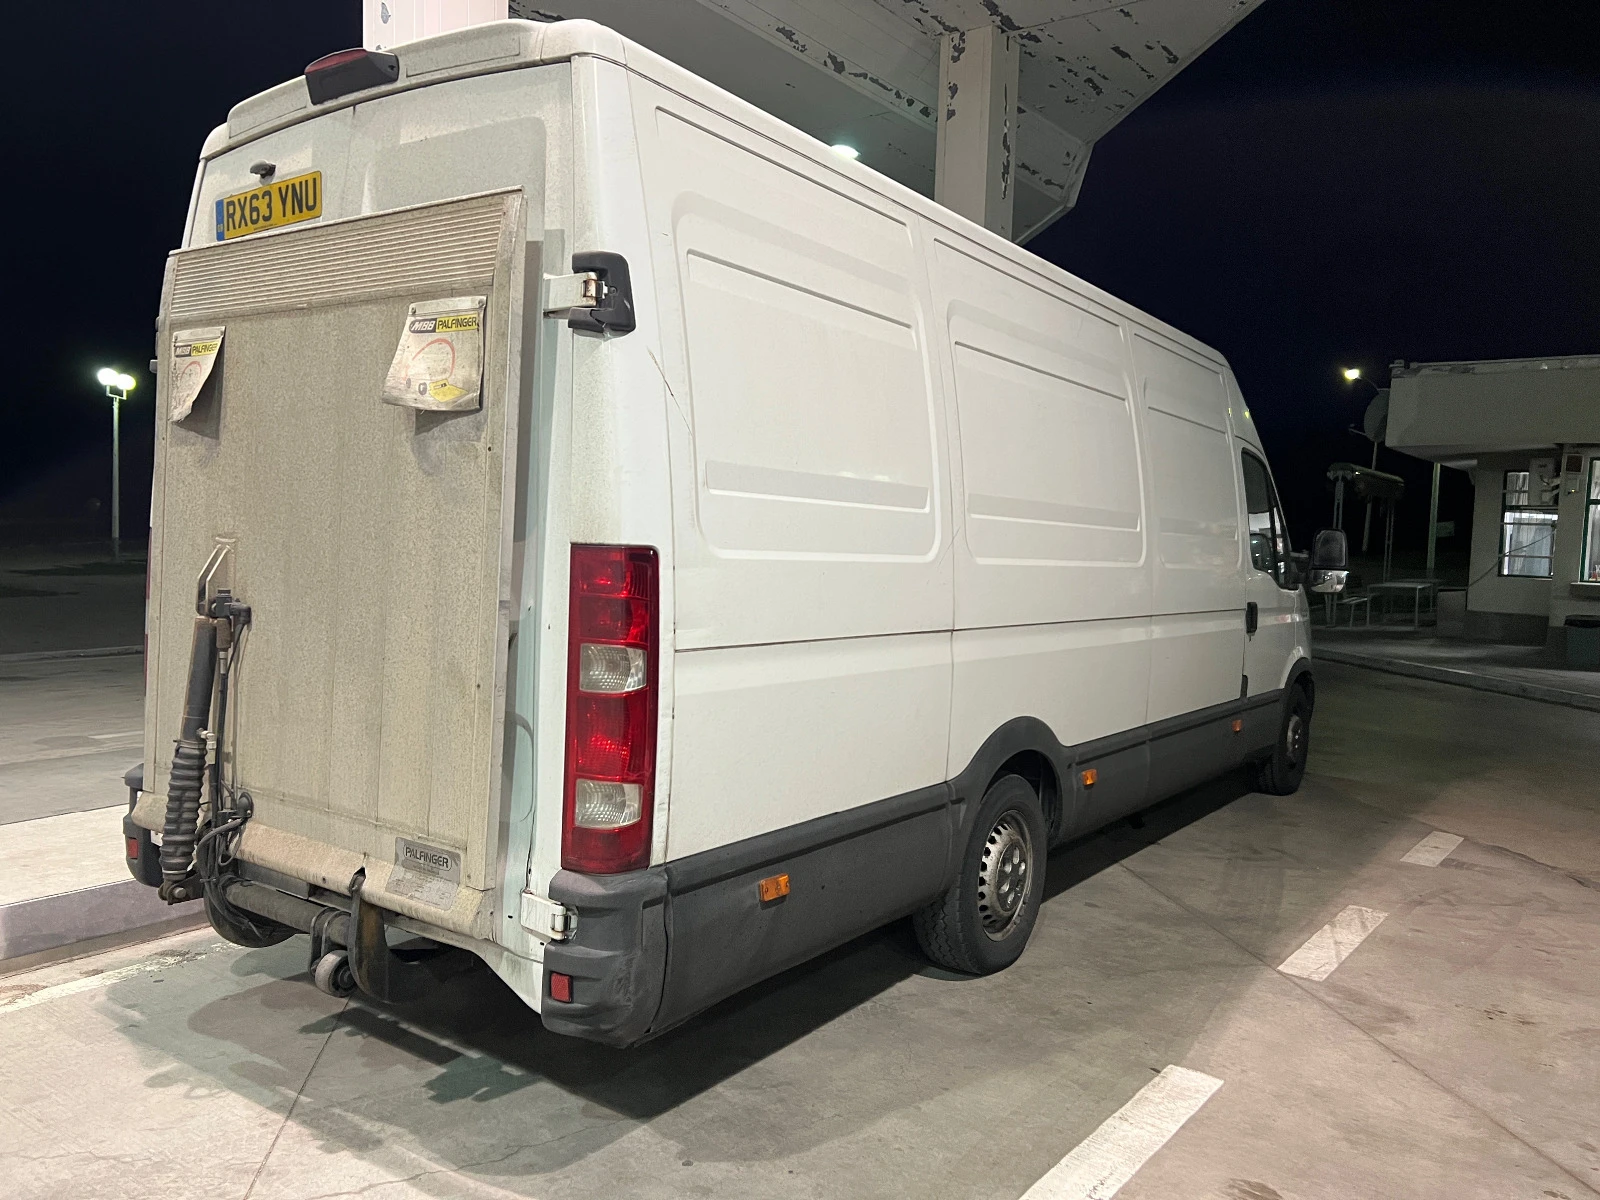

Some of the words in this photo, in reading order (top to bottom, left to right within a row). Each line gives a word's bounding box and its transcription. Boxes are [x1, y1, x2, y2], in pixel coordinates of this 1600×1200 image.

[226, 190, 273, 231] RX63
[278, 178, 317, 217] YNU
[437, 316, 477, 330] PALFINGER
[405, 847, 449, 868] PALFINGER
